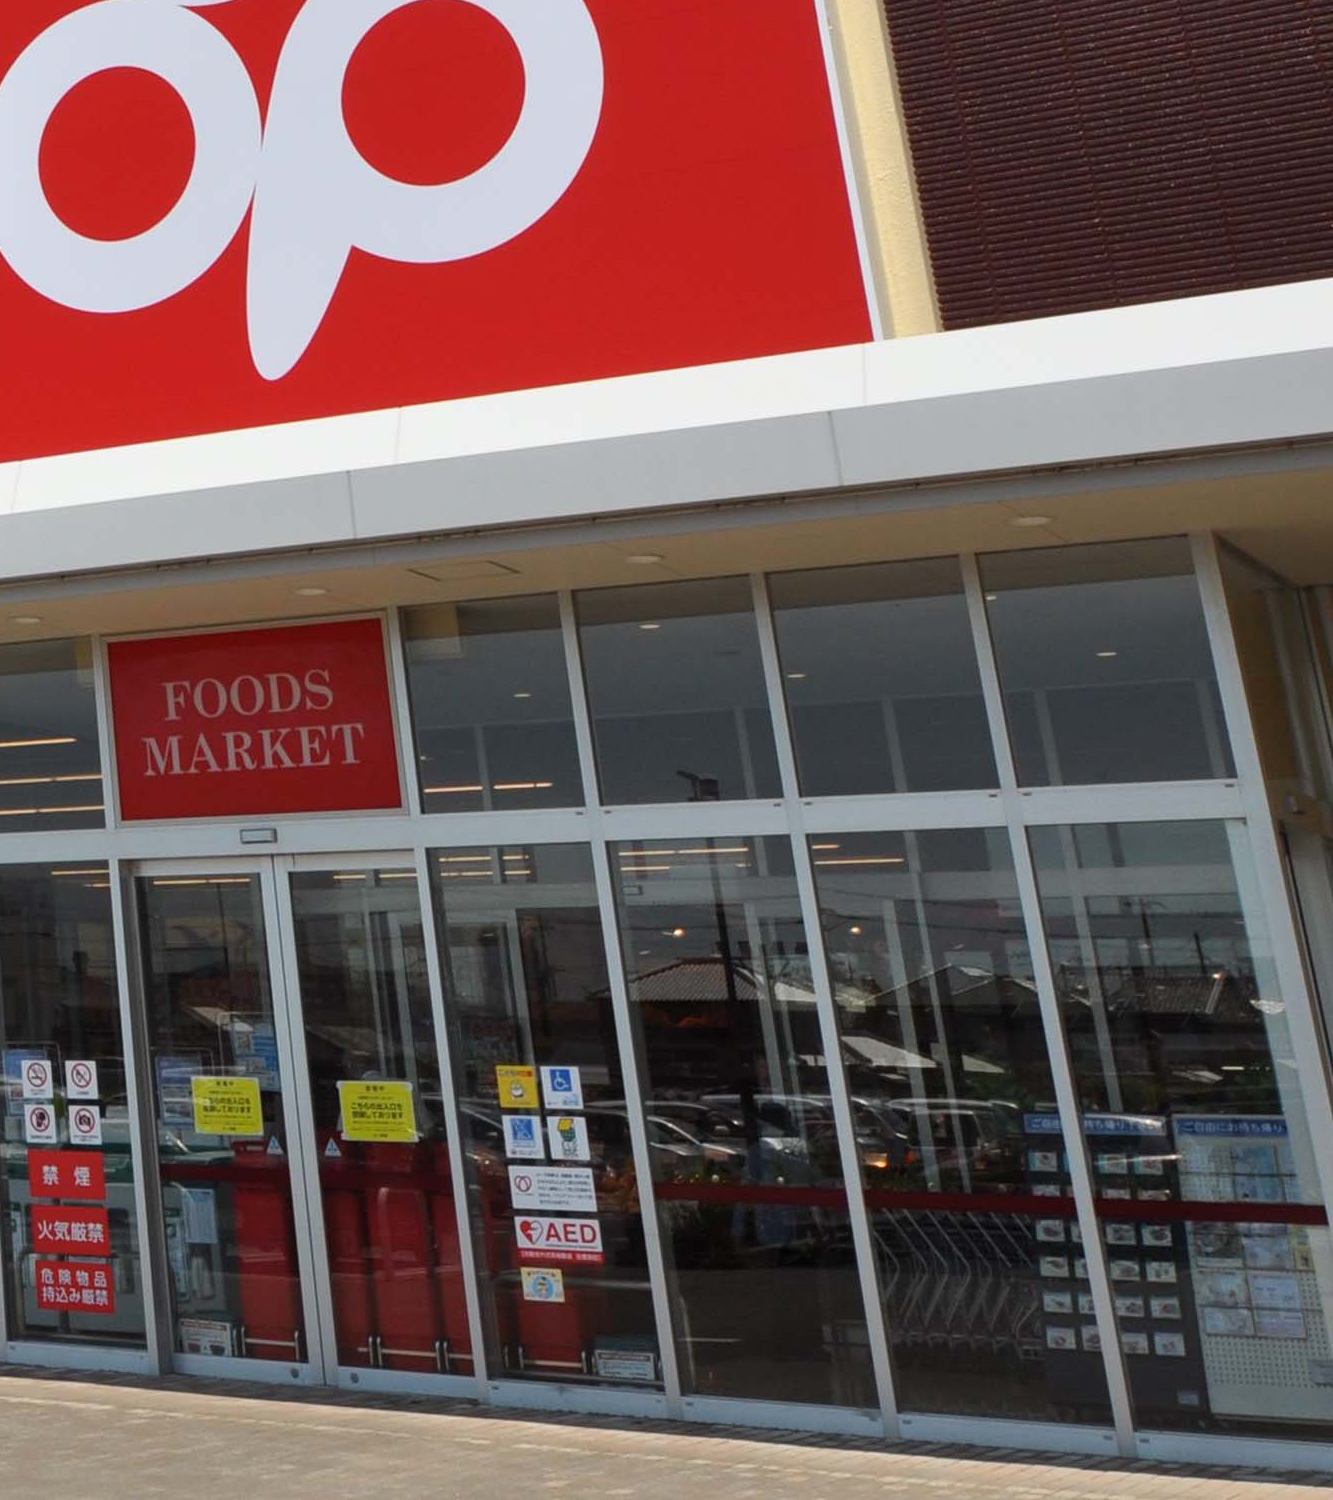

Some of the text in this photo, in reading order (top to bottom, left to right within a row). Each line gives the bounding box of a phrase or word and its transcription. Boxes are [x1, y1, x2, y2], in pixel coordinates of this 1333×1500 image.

[162, 669, 333, 721] FOODS
[142, 723, 365, 776] MARKET
[37, 1220, 104, 1243] 火気厳禁
[546, 1222, 597, 1243] AED
[42, 1286, 109, 1306] 持込み厳禁
